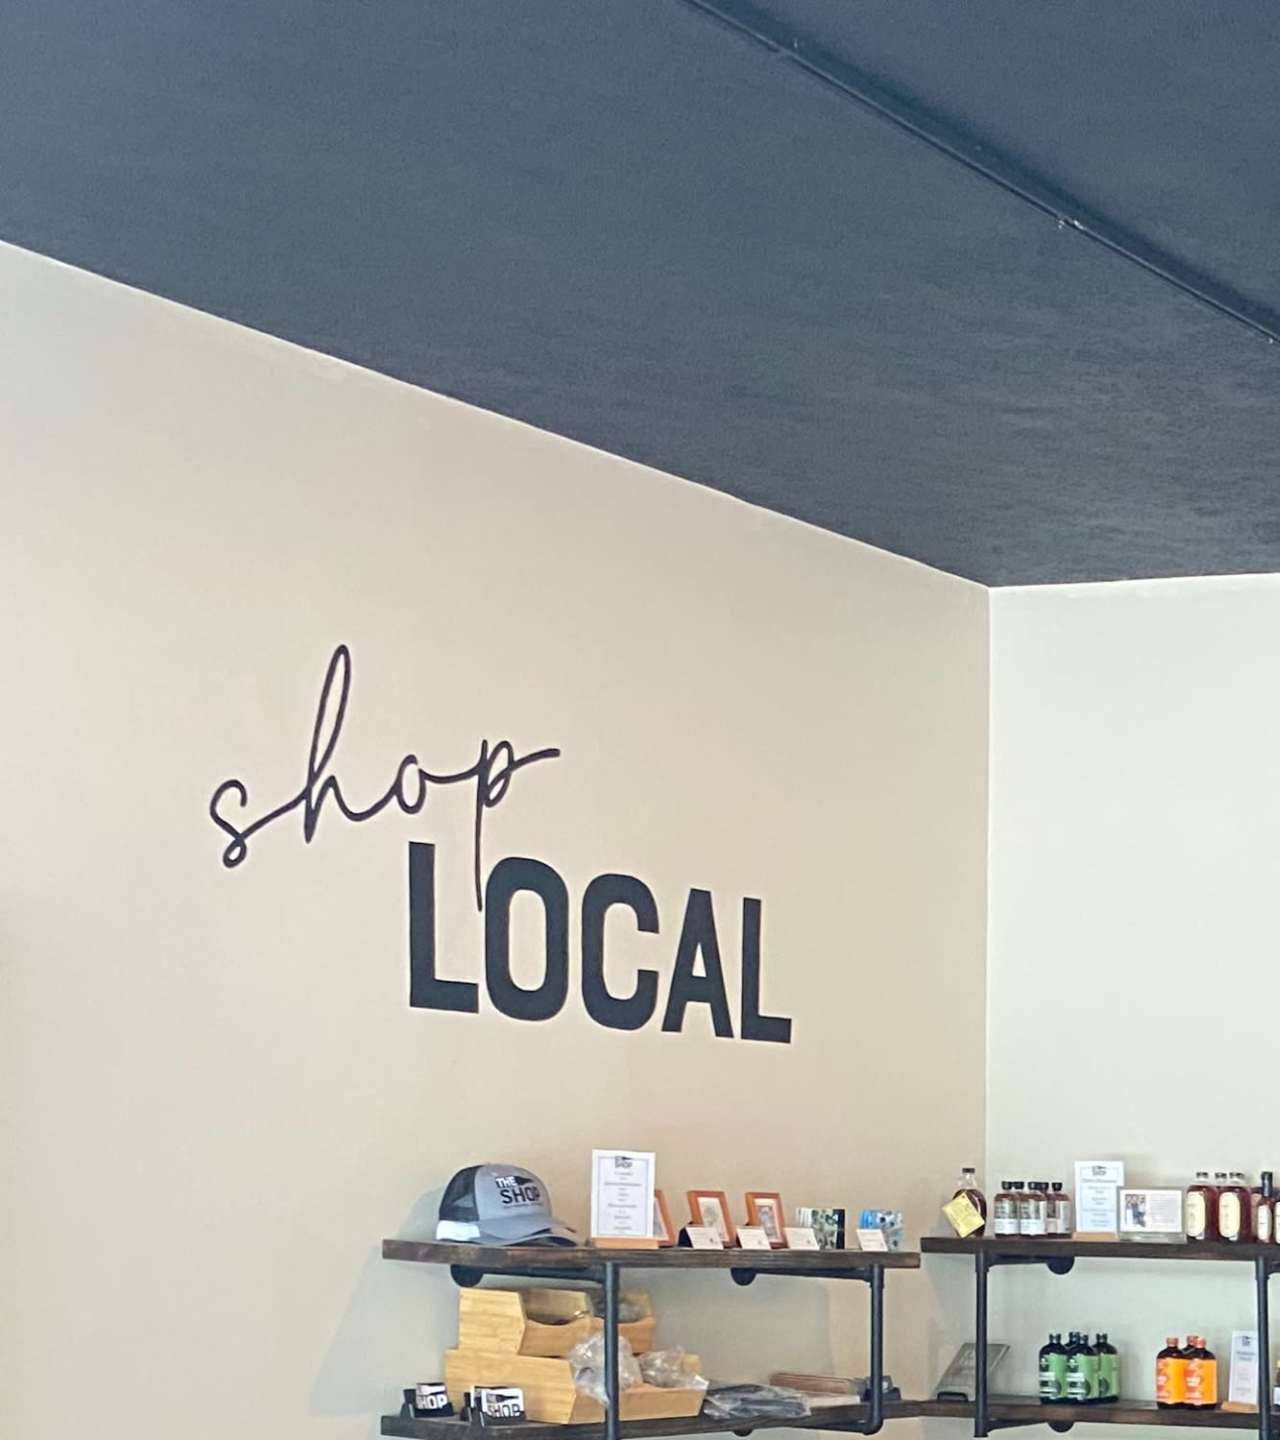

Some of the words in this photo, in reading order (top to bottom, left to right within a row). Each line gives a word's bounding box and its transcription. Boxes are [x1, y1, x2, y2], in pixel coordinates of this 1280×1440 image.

[208, 643, 561, 912] shop
[408, 840, 793, 1045] LOCAL
[495, 1176, 517, 1188] THE
[500, 1186, 541, 1204] SHOP
